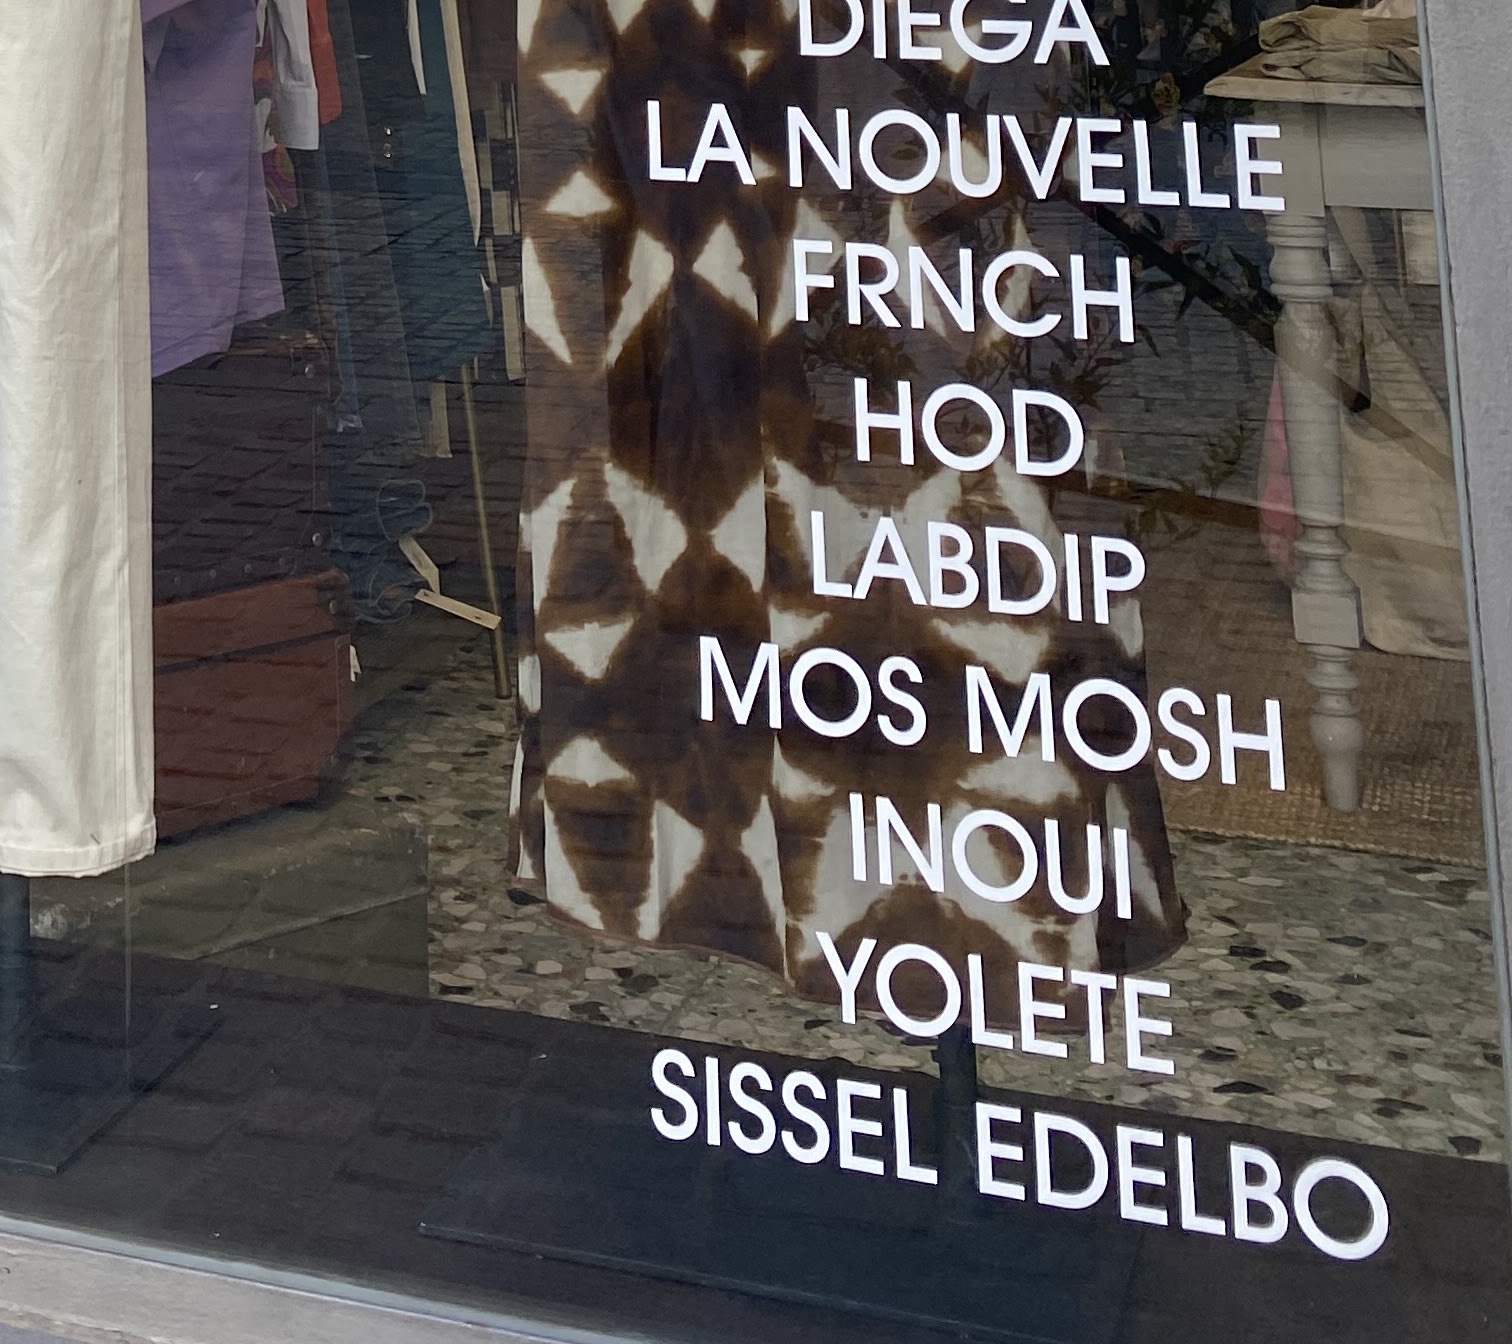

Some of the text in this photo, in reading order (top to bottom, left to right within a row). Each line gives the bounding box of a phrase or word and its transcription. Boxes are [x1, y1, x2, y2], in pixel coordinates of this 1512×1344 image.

[646, 99, 1286, 212] LA NOUVELLE
[793, 237, 1136, 344] FRNCH
[853, 377, 1085, 477] HOD
[810, 509, 1147, 624] LABDIP
[698, 636, 1286, 792] MOS MOSH
[848, 792, 1133, 920] INOUI
[814, 929, 1176, 1076] YOLETE
[649, 1048, 1390, 1261] SISSEL EDELBO
